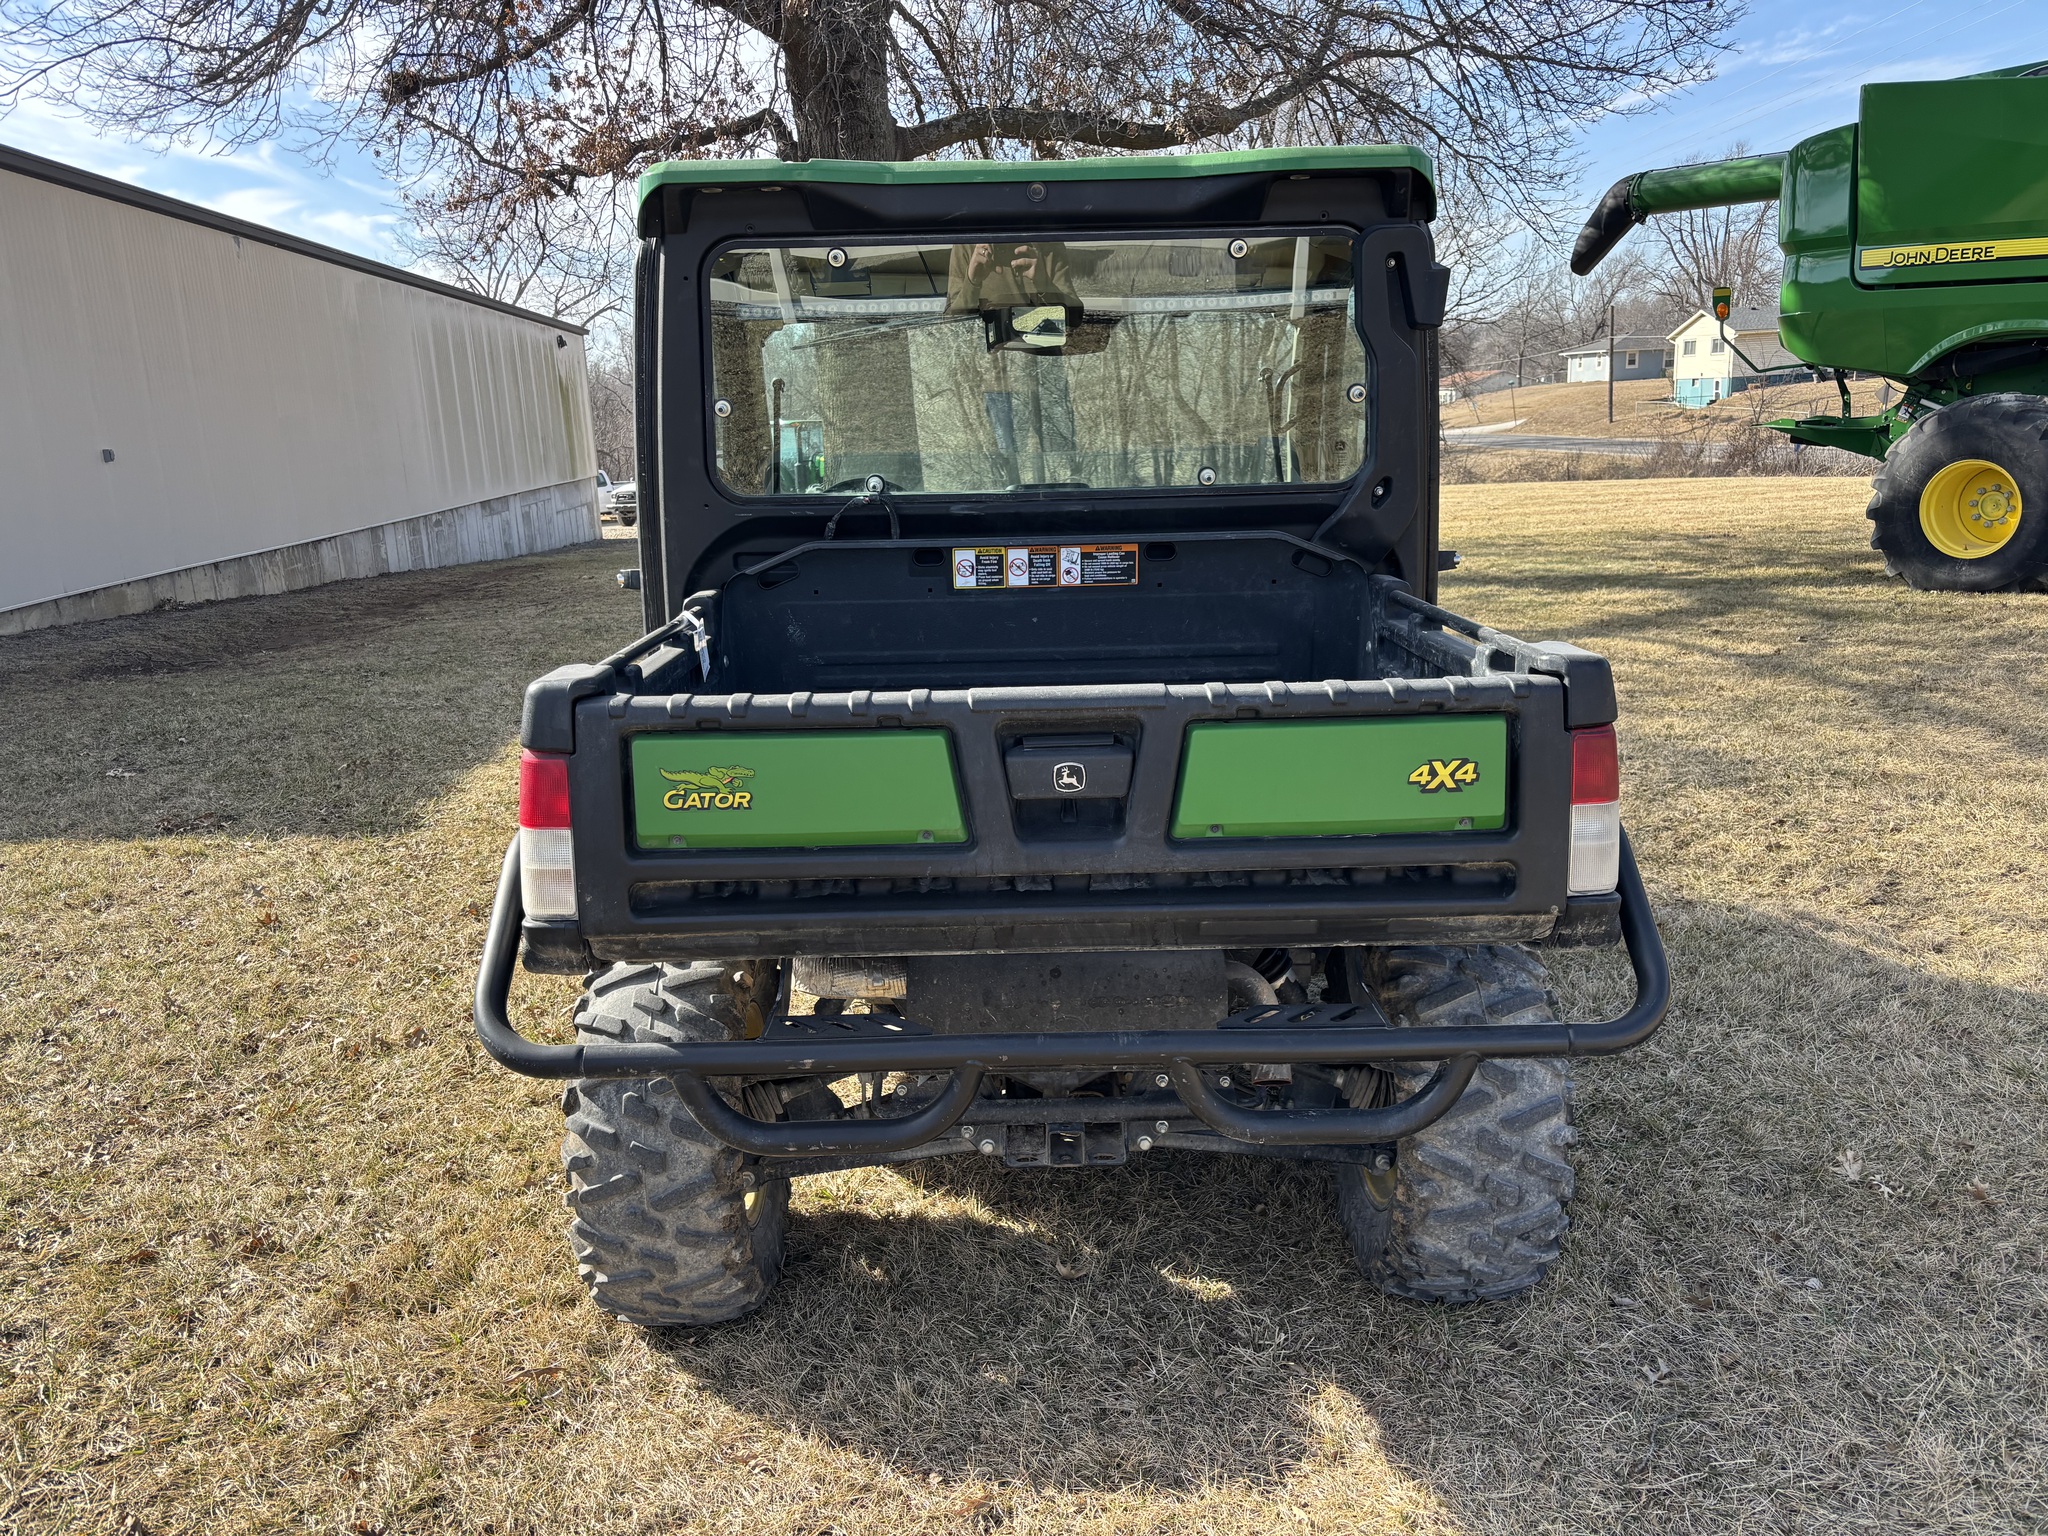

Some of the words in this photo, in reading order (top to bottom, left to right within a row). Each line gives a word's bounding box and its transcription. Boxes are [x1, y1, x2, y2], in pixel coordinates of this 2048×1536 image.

[1884, 250, 1931, 266] JOHN
[1935, 246, 1996, 262] DEERE
[1407, 758, 1481, 793] 4X4
[663, 788, 752, 811] GATOR
